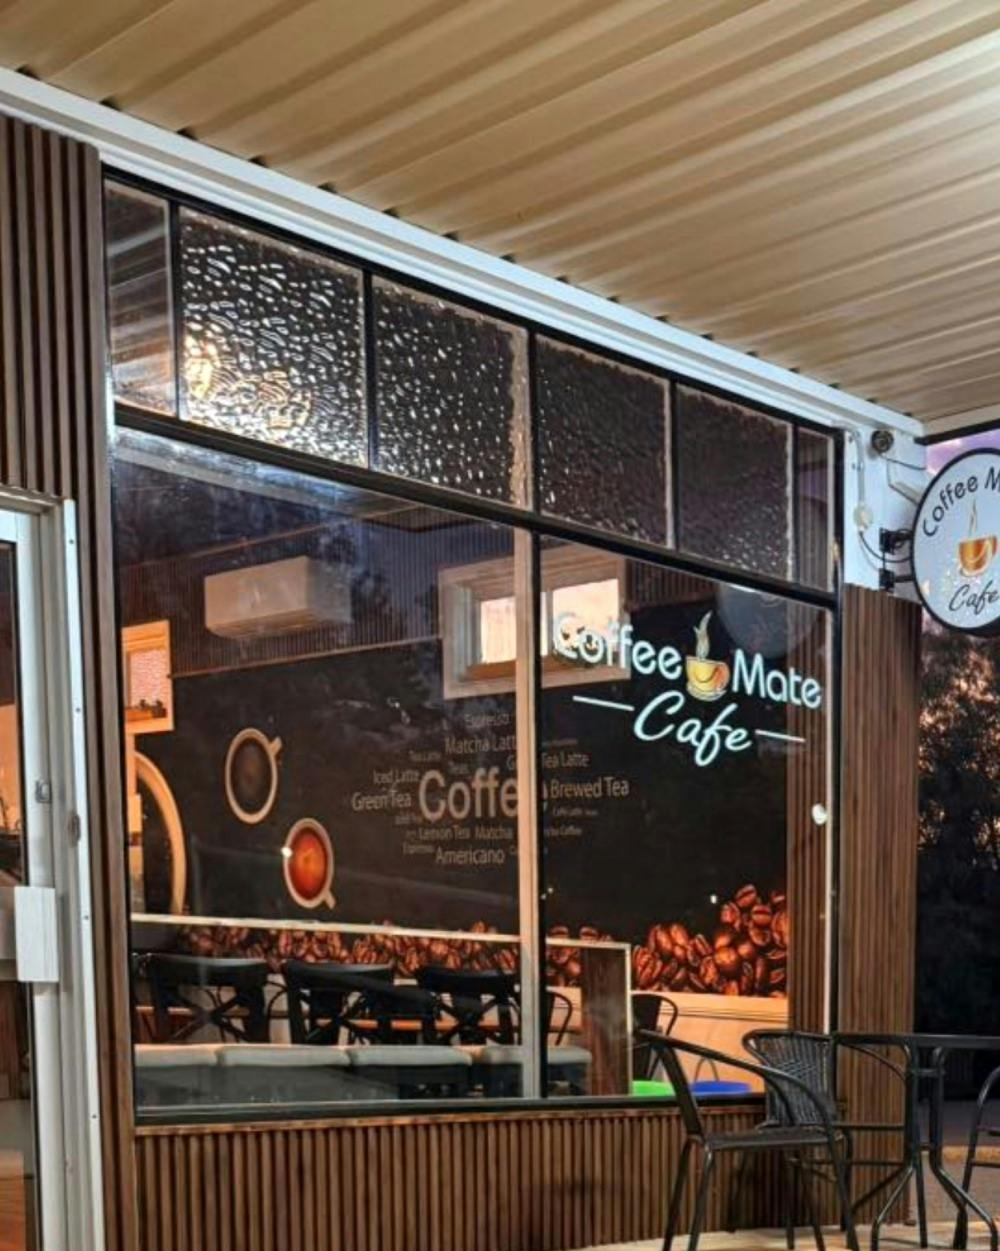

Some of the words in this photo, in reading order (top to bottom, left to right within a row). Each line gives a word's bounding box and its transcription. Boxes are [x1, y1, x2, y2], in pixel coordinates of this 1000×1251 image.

[922, 475, 979, 537] Coffee
[948, 580, 1000, 615] Cafe
[552, 612, 682, 680] Coffee
[732, 648, 822, 709] Mate
[445, 735, 490, 754] Matcha
[493, 733, 519, 752] Latt
[633, 690, 753, 767] Cafe
[352, 791, 388, 811] Green
[389, 789, 412, 809] Tea
[419, 766, 548, 821] Coffe
[551, 777, 602, 799] Brewed
[603, 775, 630, 797] Tea
[436, 845, 505, 866] Americano
